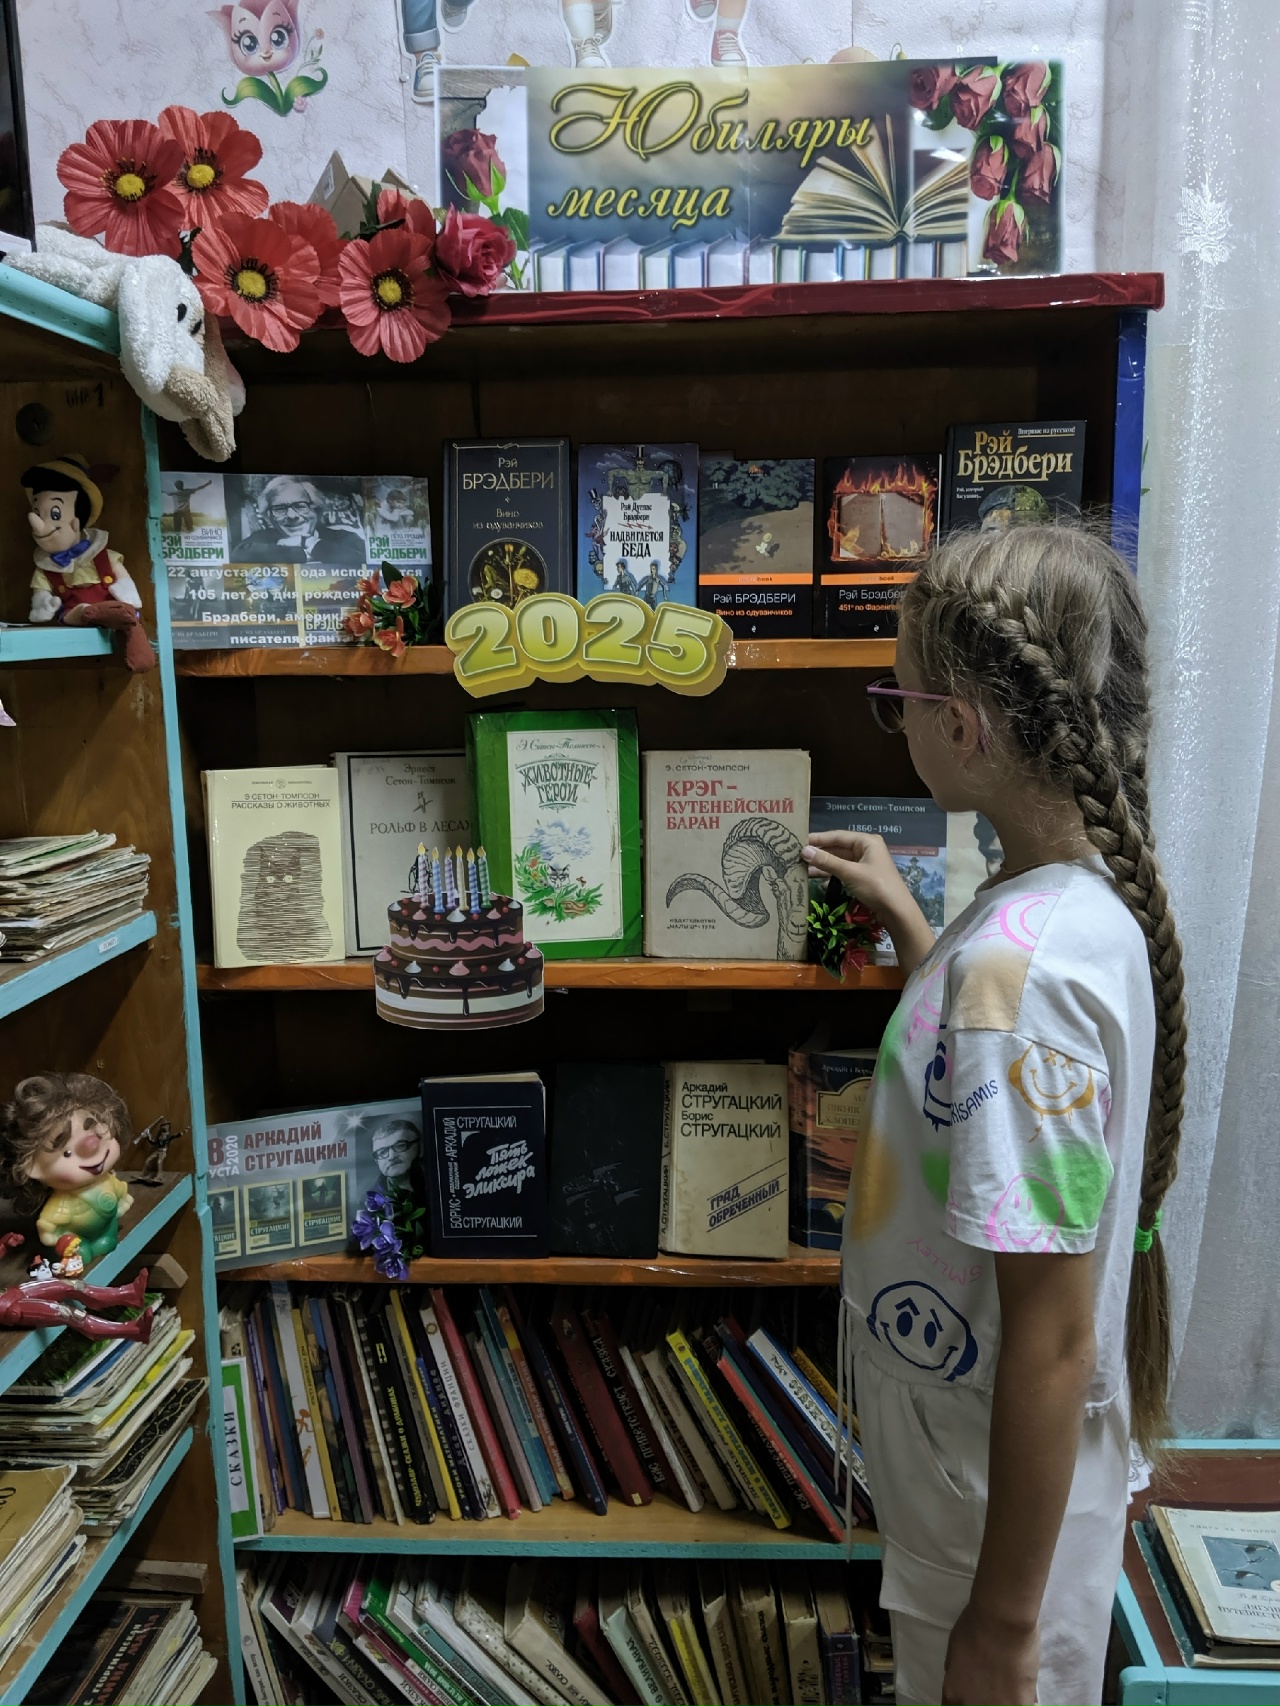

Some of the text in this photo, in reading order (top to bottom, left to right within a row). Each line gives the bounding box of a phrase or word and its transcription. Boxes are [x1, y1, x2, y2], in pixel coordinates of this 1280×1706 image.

[549, 81, 872, 168] Юбиляры
[546, 183, 731, 230] месяца
[974, 430, 1013, 454] Рэй
[498, 458, 518, 468] Рэй
[957, 445, 1073, 483] Брэдбери
[462, 473, 554, 490] БРЭДБЕРИ
[496, 508, 520, 518] Вино
[486, 521, 544, 532] одуванчиков
[161, 534, 181, 546] РЭЙ
[369, 535, 389, 547] РЭЙ
[610, 531, 664, 543] НАДВИГАЕТСЯ
[163, 548, 224, 560] БРЭДБЕРИ
[370, 548, 427, 559] БРЭДБЕРИ
[621, 543, 651, 558] БЕДА
[168, 567, 186, 578] 22
[189, 568, 247, 580] августа
[254, 567, 288, 577] 2025
[294, 568, 325, 580] года
[189, 590, 216, 600] 105
[221, 591, 247, 601] лет
[251, 591, 269, 600] со
[273, 591, 299, 602] дня
[713, 593, 796, 605] Рэй БРЭДБЕРИ
[839, 589, 906, 600] Рэй Брэдбе
[202, 611, 280, 625] Брэдбери,
[746, 609, 793, 618] одуванчиков
[449, 595, 714, 677] 2025
[404, 764, 436, 774] Эрнест
[386, 775, 456, 785] Сетон-Томпсон
[536, 783, 579, 803] ГЕРОИ
[667, 798, 794, 813] КУТЕНЕЙСКИЙ
[825, 803, 926, 813] Эрнест Сетон-Томпсон
[370, 822, 416, 834] РОЛЬФ
[419, 822, 427, 831] В
[667, 816, 720, 829] БАРАН
[848, 824, 902, 834] (1860-1946)
[682, 1082, 728, 1093] Аркадий
[682, 1094, 782, 1112] СТРУГАЦКИЙ
[456, 1116, 517, 1129] СТРУГАЦКИЙ
[682, 1110, 714, 1122] Борис
[244, 1121, 321, 1149] АРКАДИЙ
[443, 1117, 457, 1158] АРКАДИЙ
[681, 1122, 781, 1140] СТРУГАЦКИЙ
[226, 1135, 238, 1165] 2020
[245, 1140, 348, 1171] СТРУГАЦКИЙ
[486, 1140, 528, 1164] Пять
[209, 1167, 240, 1178] УСТА
[475, 1152, 534, 1181] ложек
[709, 1178, 780, 1227] ОБРЕЧЕННЫЙ
[710, 1186, 740, 1211] ГРАД
[305, 1215, 341, 1227] СТРУГАЦКИЕ
[451, 1199, 462, 1229] БОРИС
[462, 1216, 522, 1229] СТРУГАЦКИЙ
[213, 1232, 235, 1242] АЦКИЕ
[251, 1222, 290, 1236] СТРУГАЦКИЕ
[682, 1356, 715, 1404] малышей
[439, 1359, 475, 1451] СКАЗКИ ФРАНЦИИ
[590, 1336, 666, 1483] ВАС ПРИВЕТСТВУЕТ СКАЗКА
[710, 1403, 726, 1423] для
[224, 1411, 243, 1487] СКАЗКИ
[398, 1435, 412, 1464] СКАЗКИ
[430, 1405, 466, 1499] УРОКИ МАТЕМАТИКИ
[721, 1422, 757, 1476] животных
[756, 1484, 782, 1521] Сказки
[342, 1654, 374, 1692] СКАЗКИ
[625, 1636, 659, 1695] ВЕЛИКАНАХ
[335, 1671, 370, 1705] СКАЗКИ
[415, 1670, 438, 1691] СКАЗКИ
[400, 1680, 426, 1705] КАЗКИ
